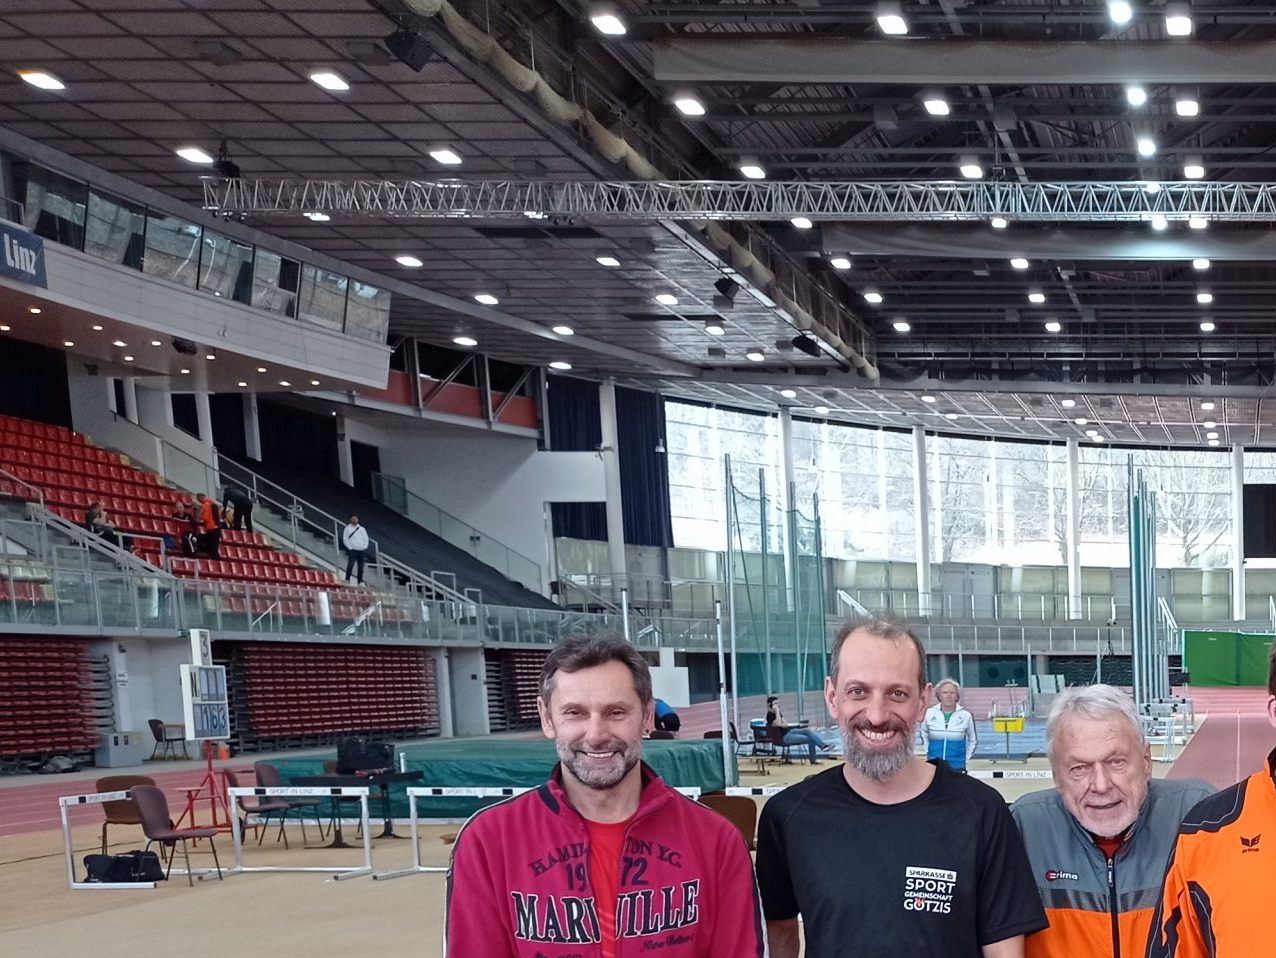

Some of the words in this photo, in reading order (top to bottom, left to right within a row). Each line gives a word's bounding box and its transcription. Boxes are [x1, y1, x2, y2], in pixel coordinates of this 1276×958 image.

[4, 233, 36, 275] Linz
[909, 869, 946, 879] SPARKASSE
[905, 878, 956, 895] SPORT
[904, 891, 953, 901] GEMEINSCHAFT
